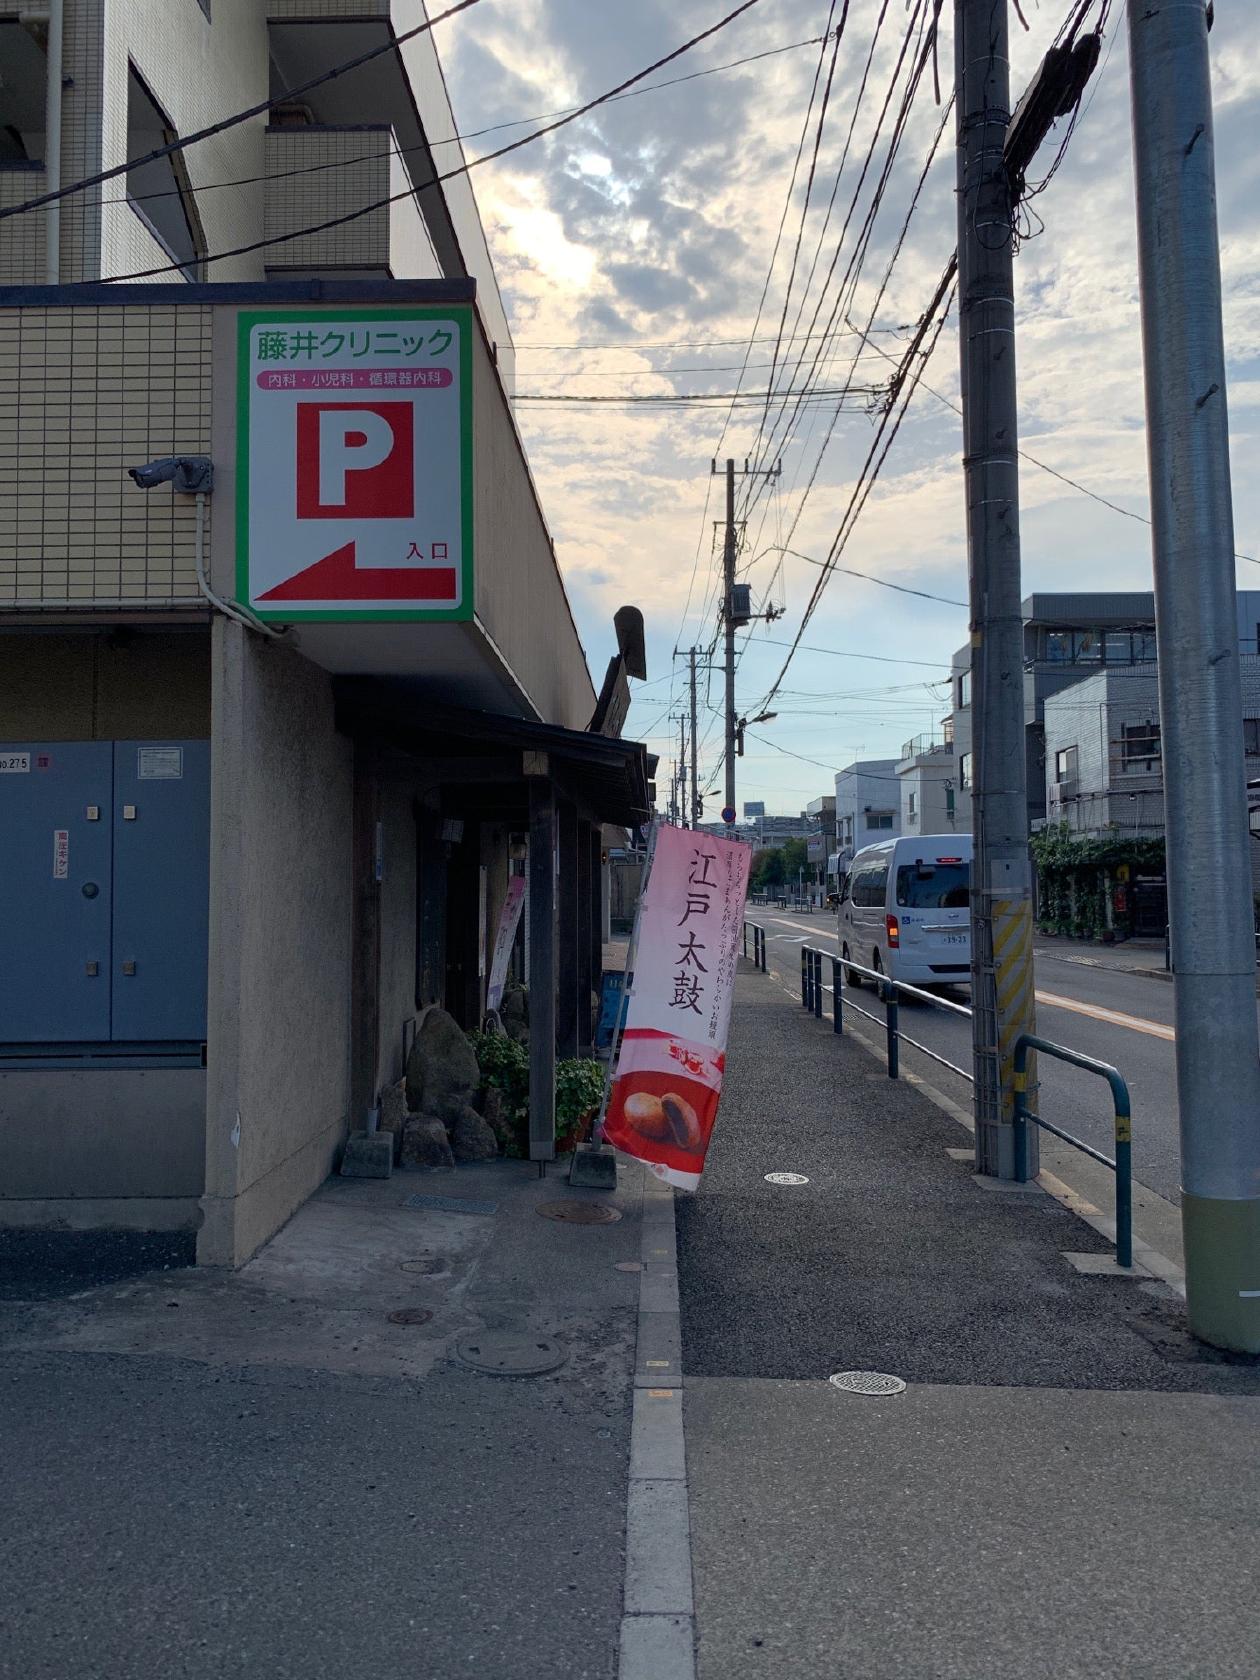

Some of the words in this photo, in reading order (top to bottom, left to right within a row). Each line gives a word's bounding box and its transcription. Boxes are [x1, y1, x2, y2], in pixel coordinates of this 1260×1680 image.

[257, 329, 453, 360] 藤井クリニック
[268, 371, 442, 387] 内科・小児科・循環器内科
[319, 410, 395, 506] P
[406, 543, 448, 560] 入口
[668, 849, 717, 1015] 江戸太鼓
